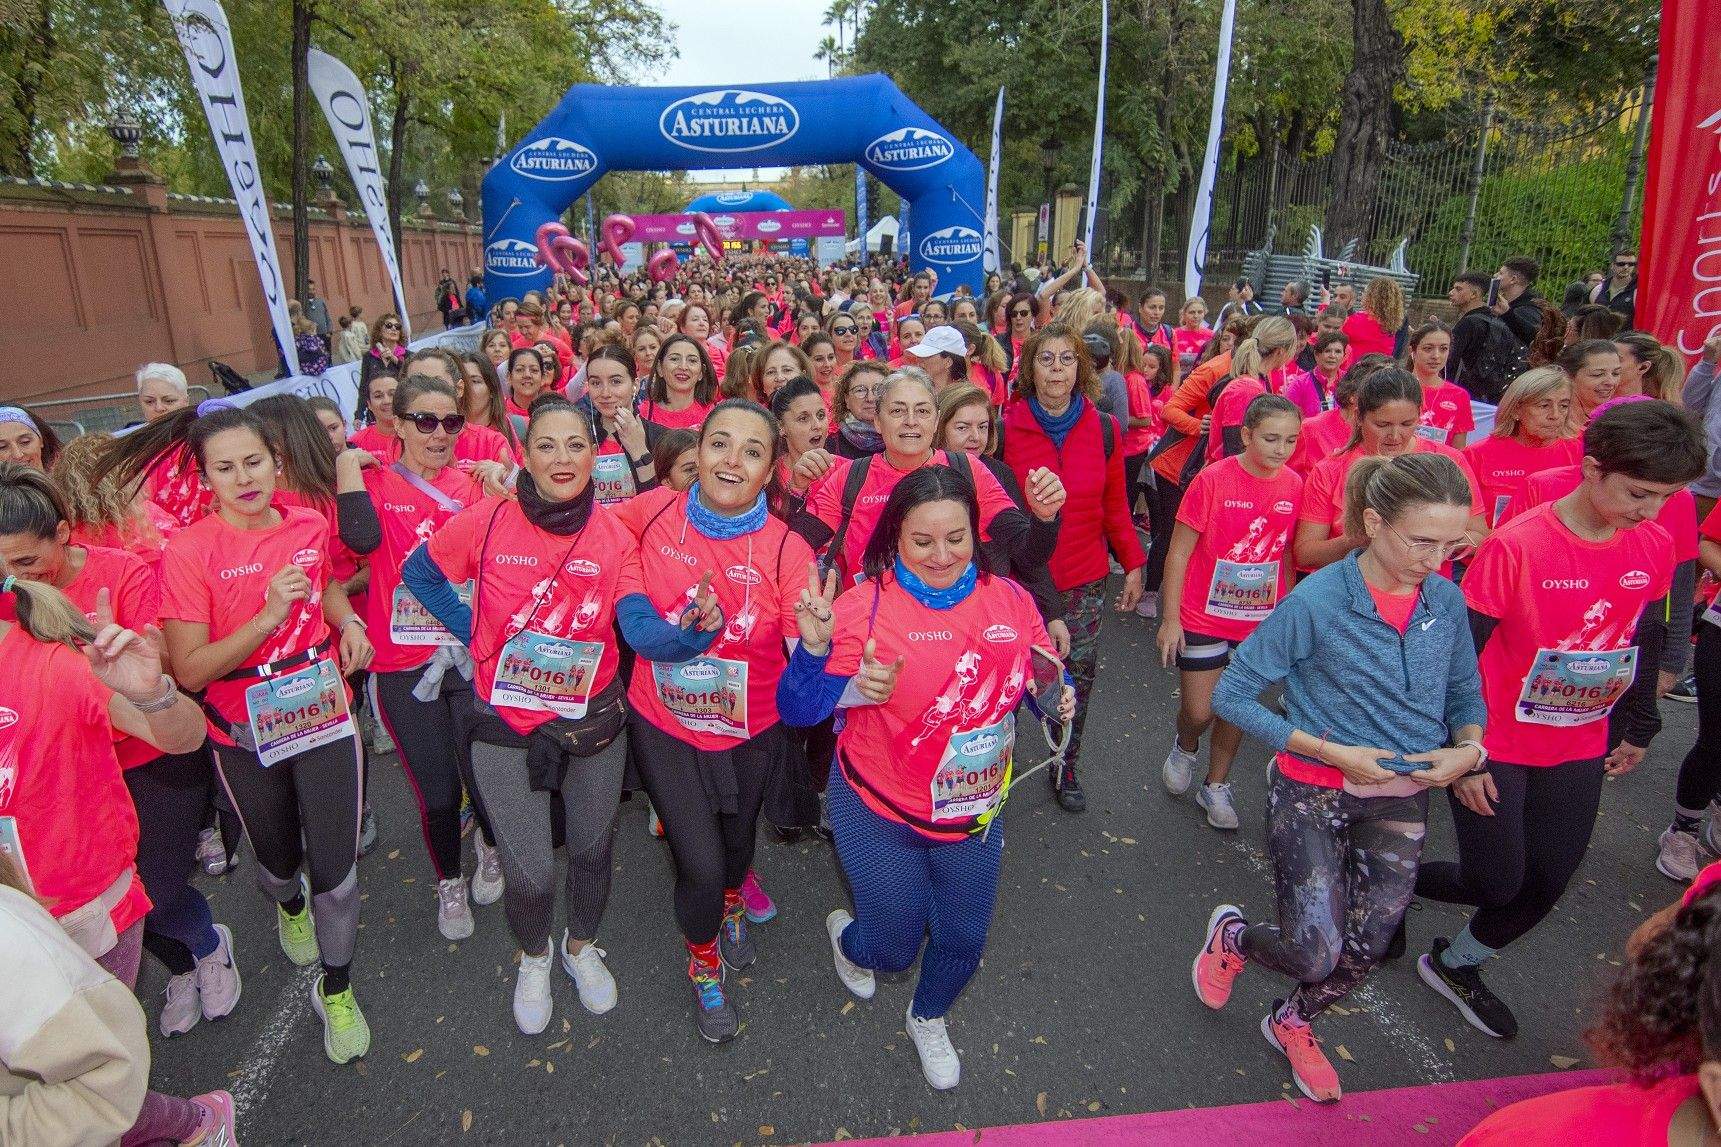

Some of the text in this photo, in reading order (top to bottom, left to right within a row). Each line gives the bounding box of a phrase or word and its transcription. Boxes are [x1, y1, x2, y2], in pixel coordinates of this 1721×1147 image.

[691, 107, 784, 116] CENTRAL LECHERA
[671, 110, 789, 137] ASTURIANA
[873, 145, 950, 162] ASTURIANA
[515, 153, 591, 171] ASTURIANA
[1492, 469, 1526, 478] OYSHO
[1224, 499, 1254, 510] OYSHO
[495, 553, 539, 568] OYSHO
[661, 545, 697, 566] OYSHO
[220, 562, 263, 580] OYSHO
[1541, 579, 1590, 590] OYSHO
[1235, 589, 1260, 599] 016
[908, 630, 953, 642] OYSHO
[530, 667, 566, 686] 016
[534, 683, 551, 693] 1301
[1561, 684, 1602, 699] 016
[501, 693, 532, 704] OYSHO
[685, 691, 721, 705] 016
[284, 703, 321, 725] 016
[1534, 703, 1558, 712] CARRERA
[269, 742, 300, 759] OYSHO
[966, 762, 998, 786] 016
